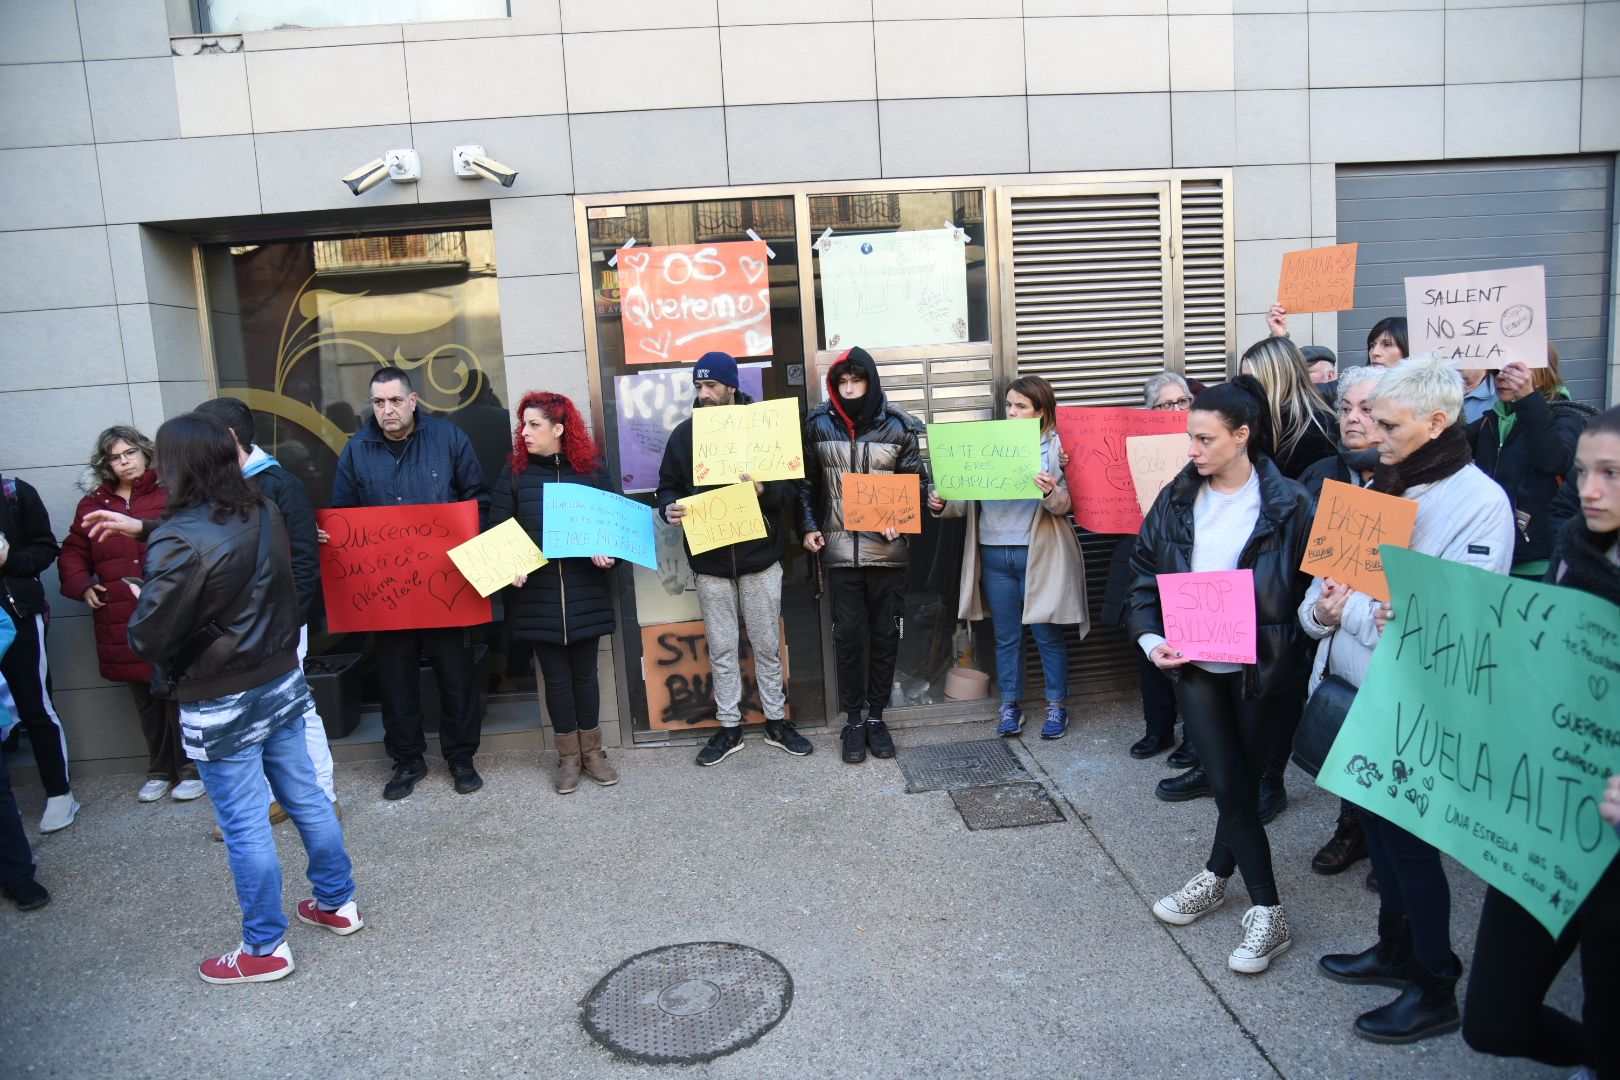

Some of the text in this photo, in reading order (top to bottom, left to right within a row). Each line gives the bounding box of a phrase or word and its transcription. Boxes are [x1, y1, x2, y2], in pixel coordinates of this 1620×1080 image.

[663, 247, 727, 285] OS
[625, 287, 769, 328] Queremos
[1421, 285, 1508, 307] SALLENT
[1425, 316, 1495, 339] NO SE
[698, 442, 718, 458] NO
[936, 443, 1032, 459] SI TE CALLAS
[965, 461, 994, 471] ERES
[851, 481, 912, 506] BASTA
[691, 497, 728, 527] NO
[875, 507, 900, 527] YA
[1327, 496, 1387, 543] BASTA
[321, 513, 450, 552] Queremos
[690, 519, 764, 545] SILENCIO
[465, 541, 501, 569] NO
[1332, 536, 1362, 576] YA
[1176, 579, 1232, 613] STOP
[1166, 614, 1248, 645] BULLYING
[1396, 593, 1498, 705] ALANA
[1396, 701, 1604, 853] VUELA ALTO
[1444, 804, 1470, 832] UNA
[1471, 822, 1518, 854] ESTRELLA
[1482, 849, 1498, 865] EN
[1502, 862, 1517, 876] EL
